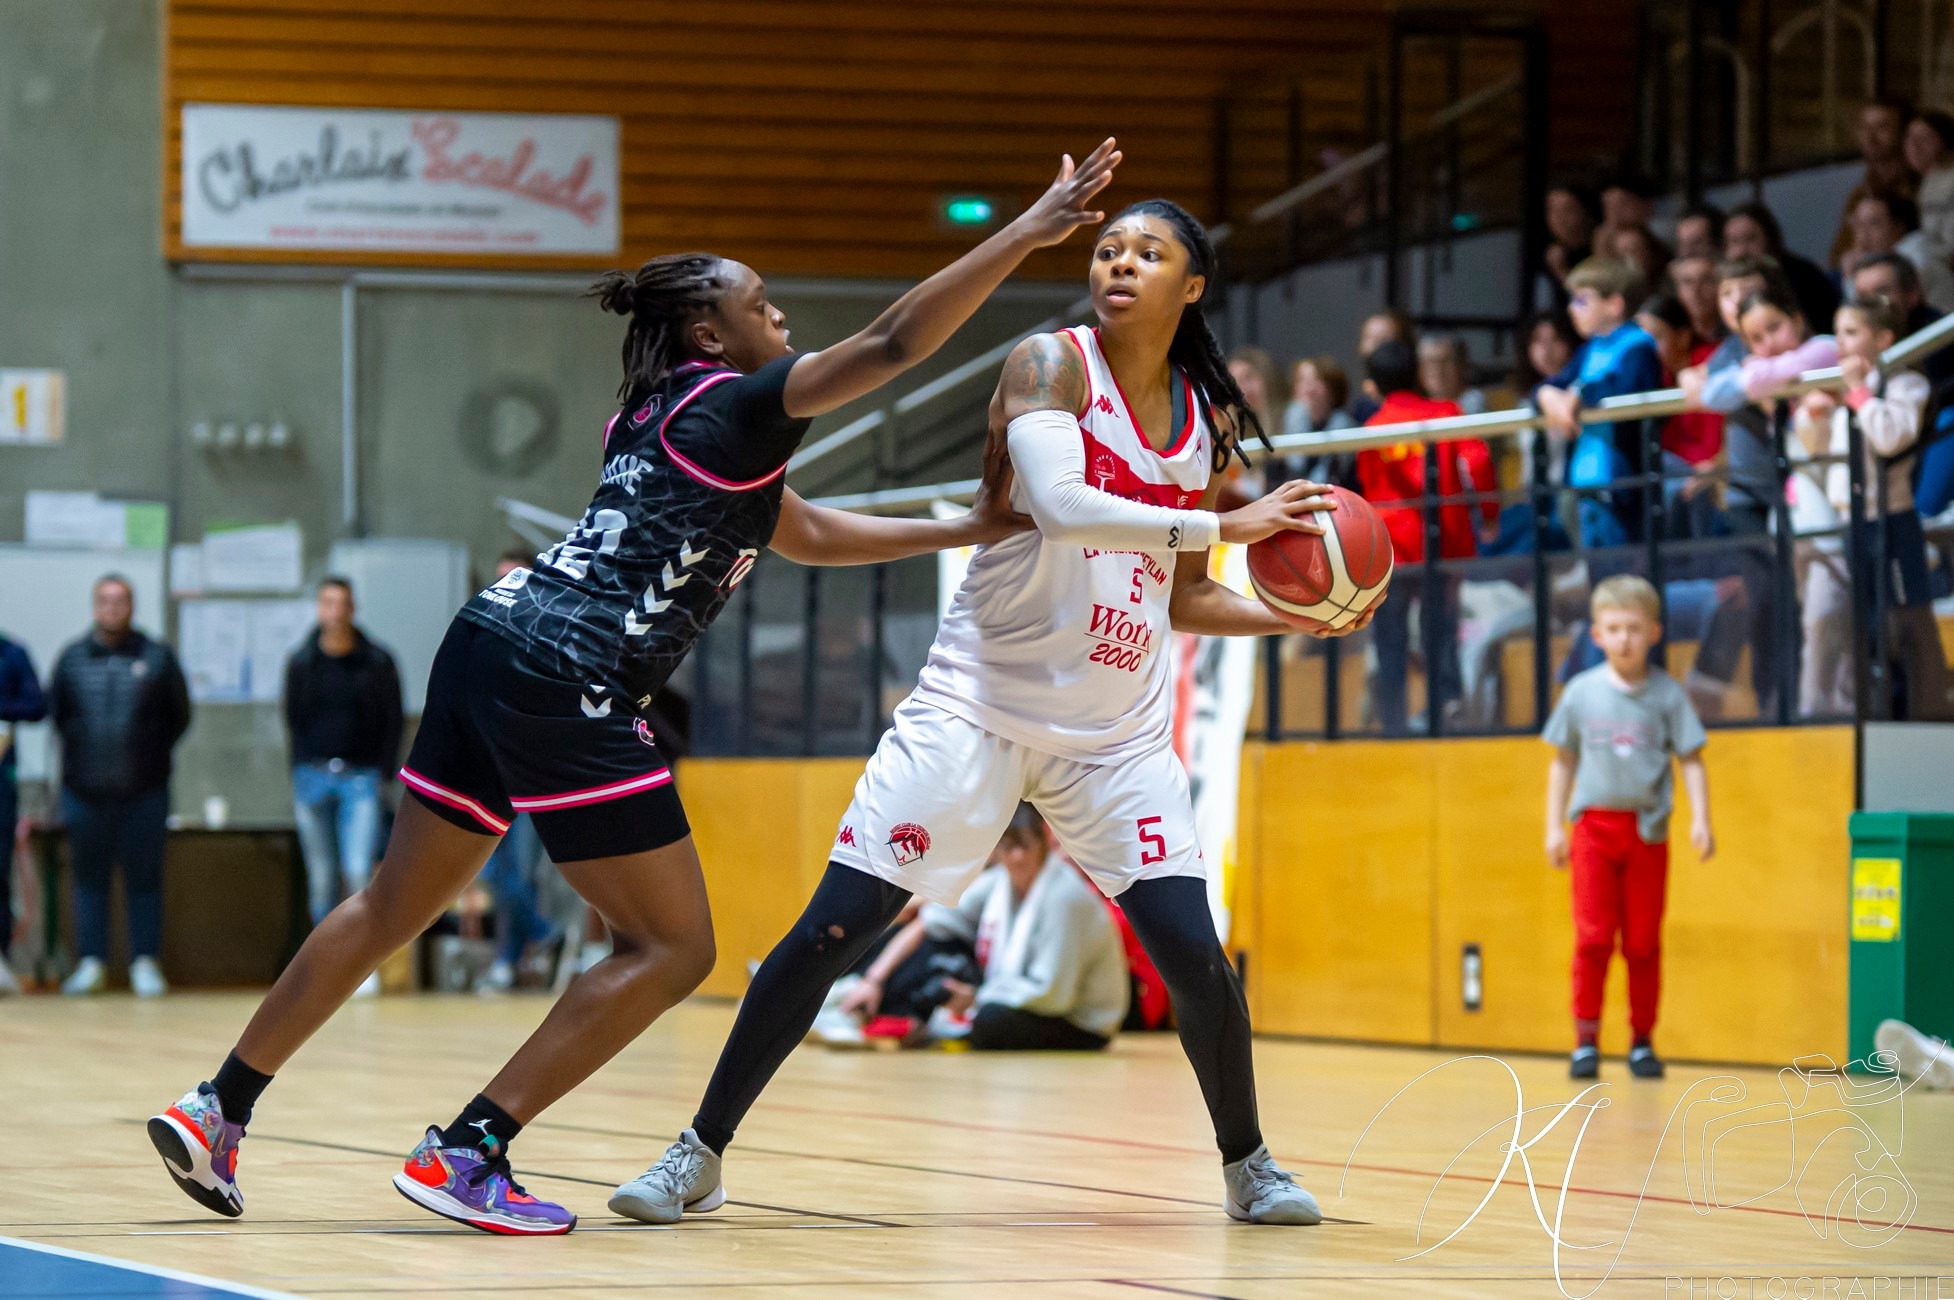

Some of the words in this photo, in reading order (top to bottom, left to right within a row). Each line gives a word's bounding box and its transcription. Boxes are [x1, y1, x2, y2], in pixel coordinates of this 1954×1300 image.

[1129, 567, 1144, 604] 5
[1089, 643, 1142, 673] 2000
[1136, 815, 1167, 866] 5
